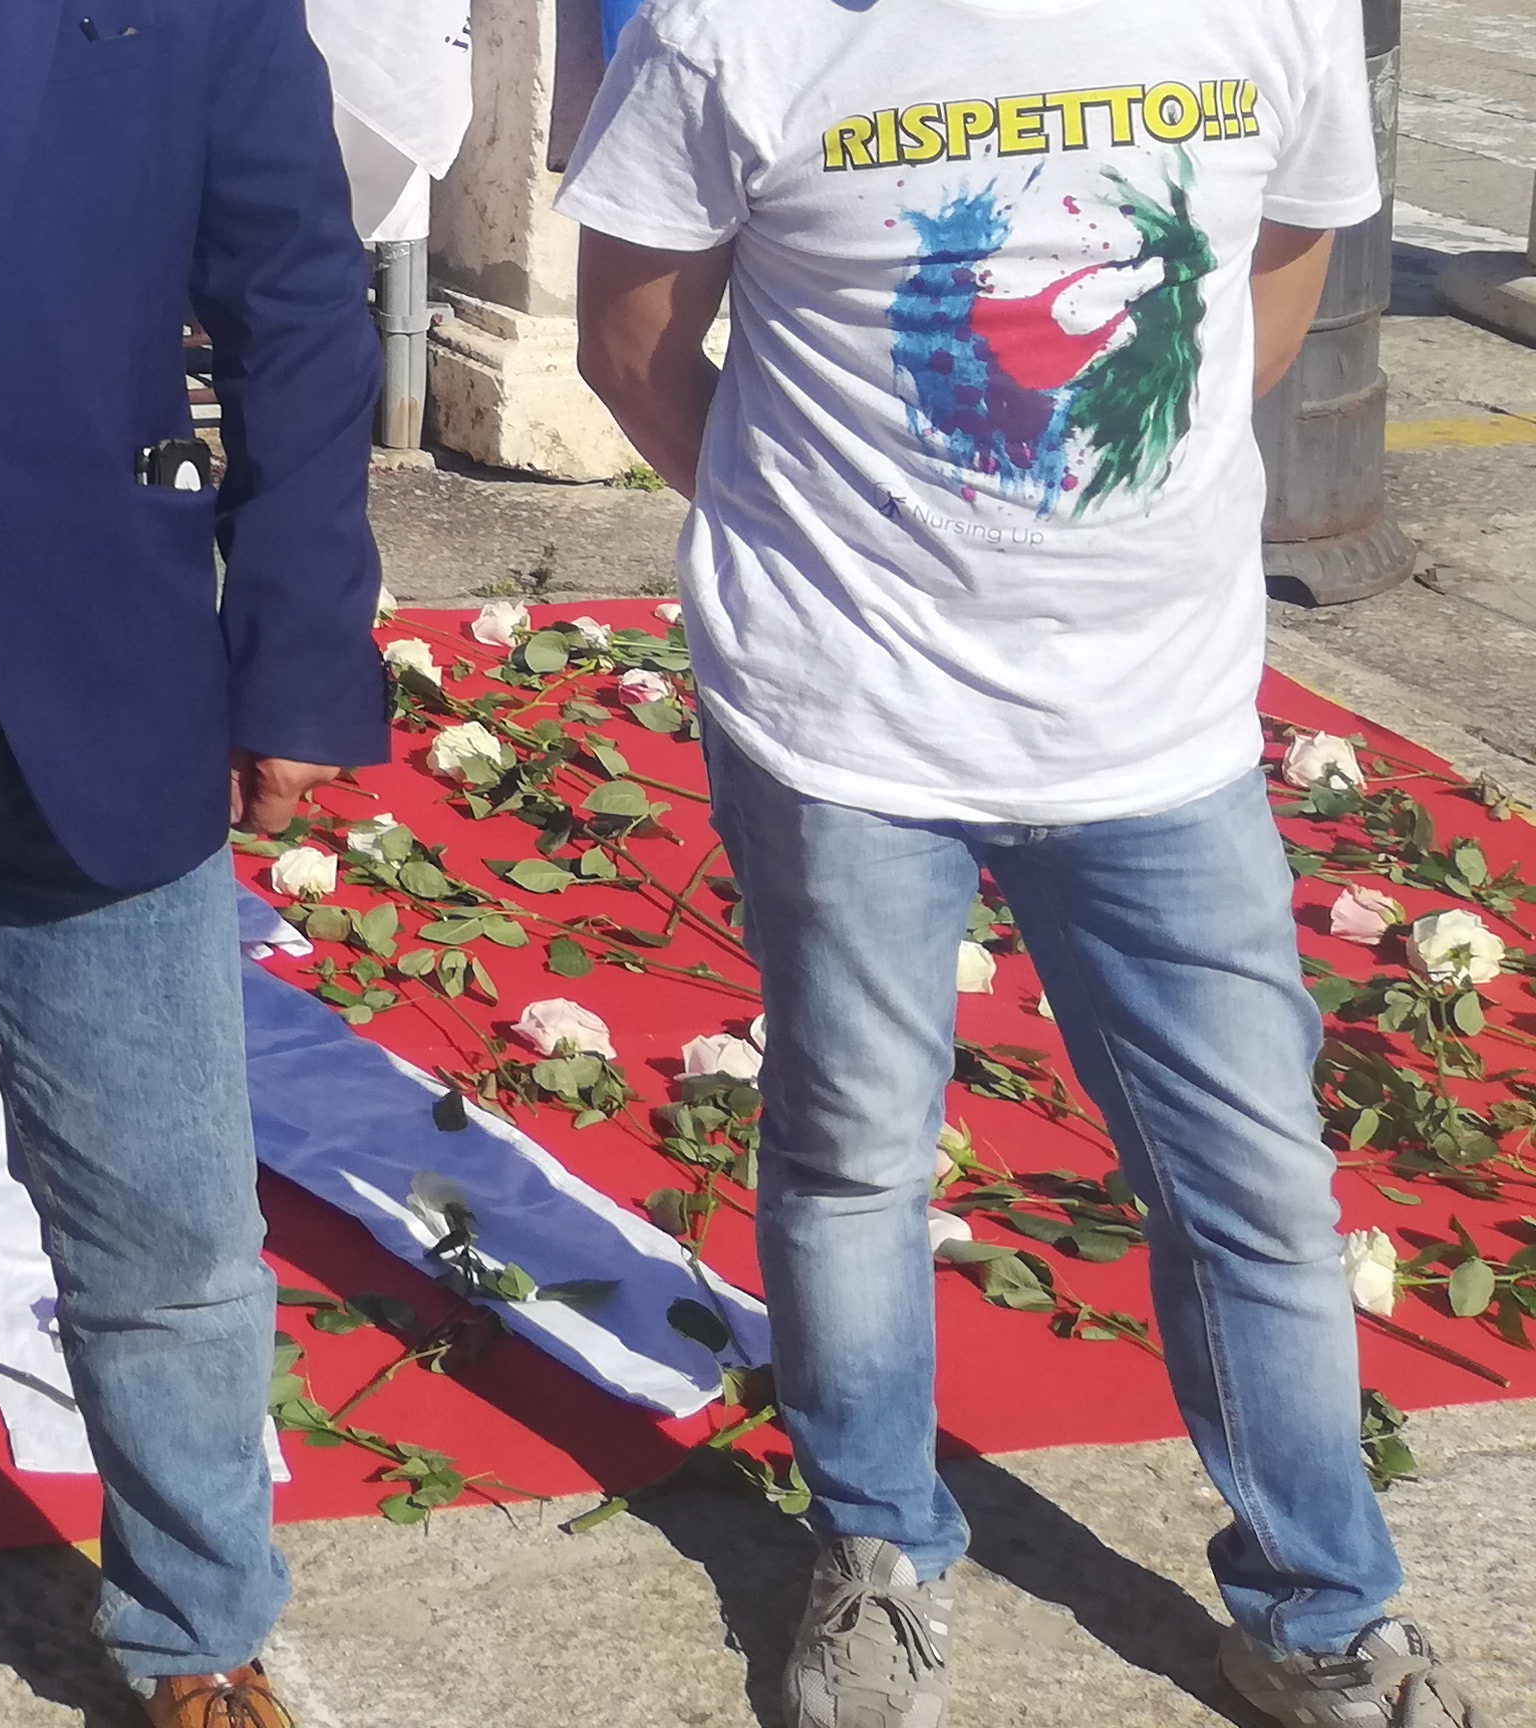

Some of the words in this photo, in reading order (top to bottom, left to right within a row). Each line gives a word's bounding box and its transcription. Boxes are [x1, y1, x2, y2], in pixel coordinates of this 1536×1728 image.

[823, 78, 1260, 172] RISPETTO!!!
[913, 504, 1002, 545] Nursing
[1011, 527, 1045, 548] Up
